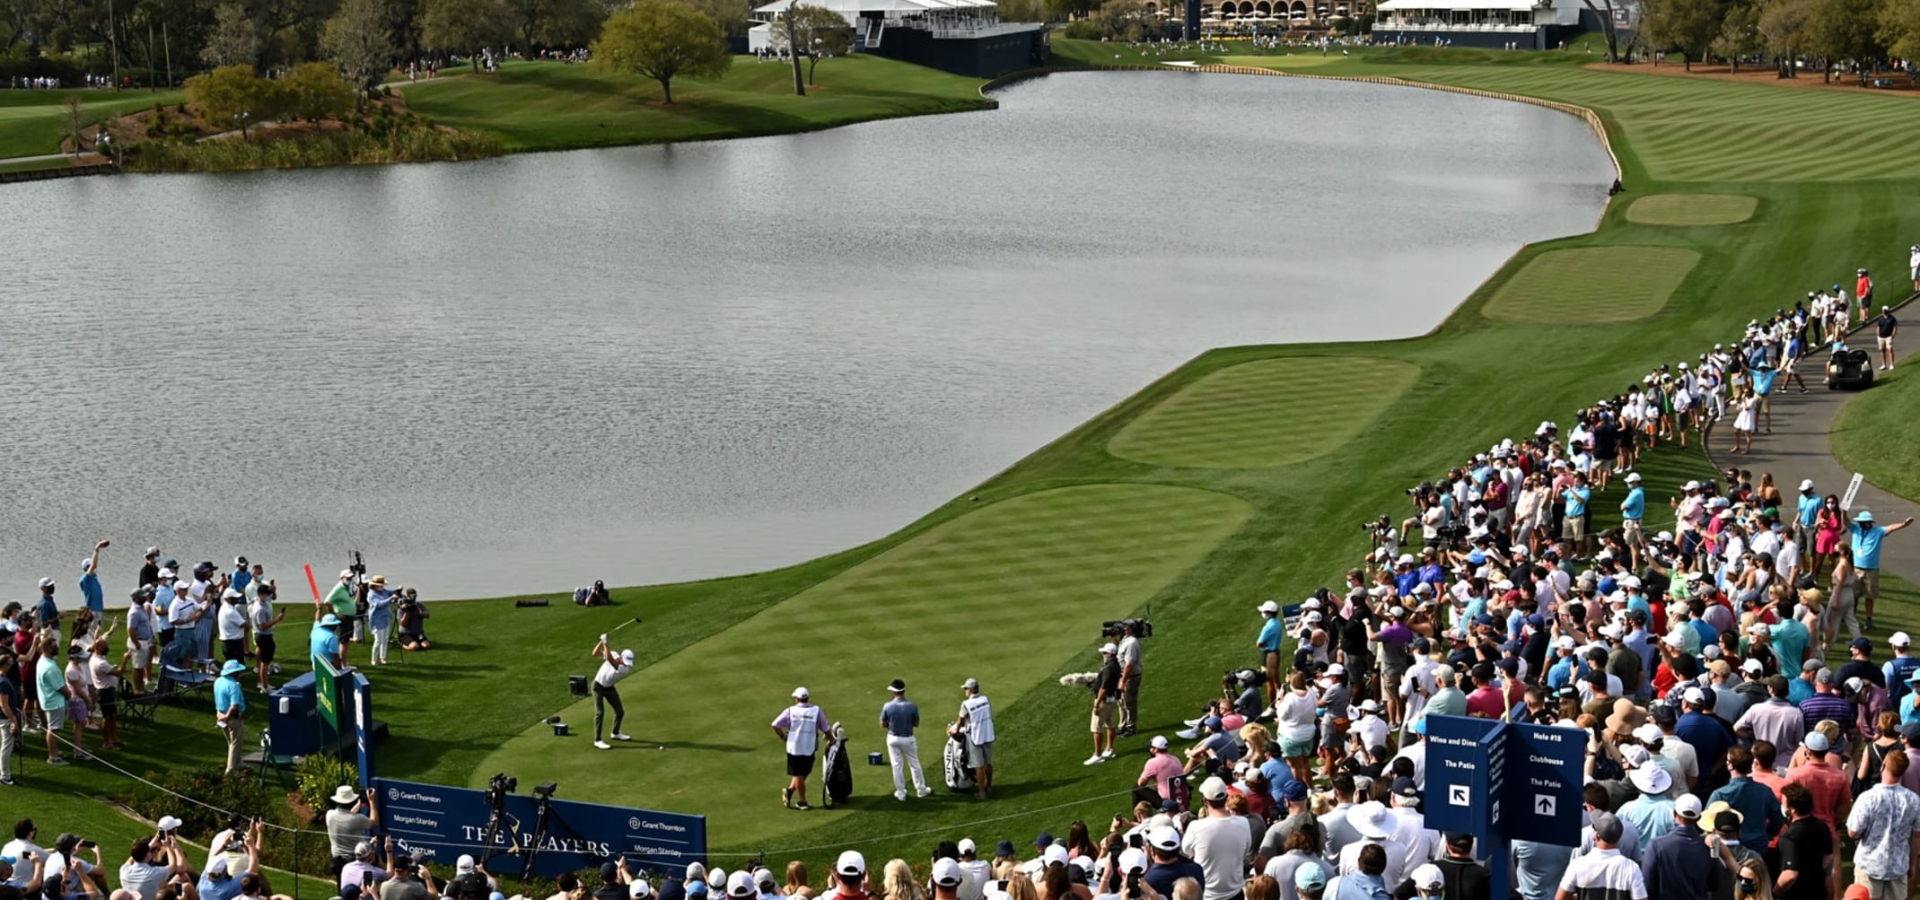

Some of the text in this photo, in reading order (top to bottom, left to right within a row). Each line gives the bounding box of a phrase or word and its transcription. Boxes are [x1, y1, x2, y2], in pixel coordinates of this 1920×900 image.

[1429, 735, 1447, 744] Wine
[1448, 738, 1460, 746] and
[1461, 738, 1477, 747] Dine
[1533, 732, 1562, 743] Hole #18
[1445, 759, 1476, 770] The Patio
[1529, 754, 1564, 766] Clubhouse
[1530, 777, 1562, 788] The Patio
[393, 814, 438, 828] Morgan Stanley
[634, 844, 682, 858] Morgan Stanley
